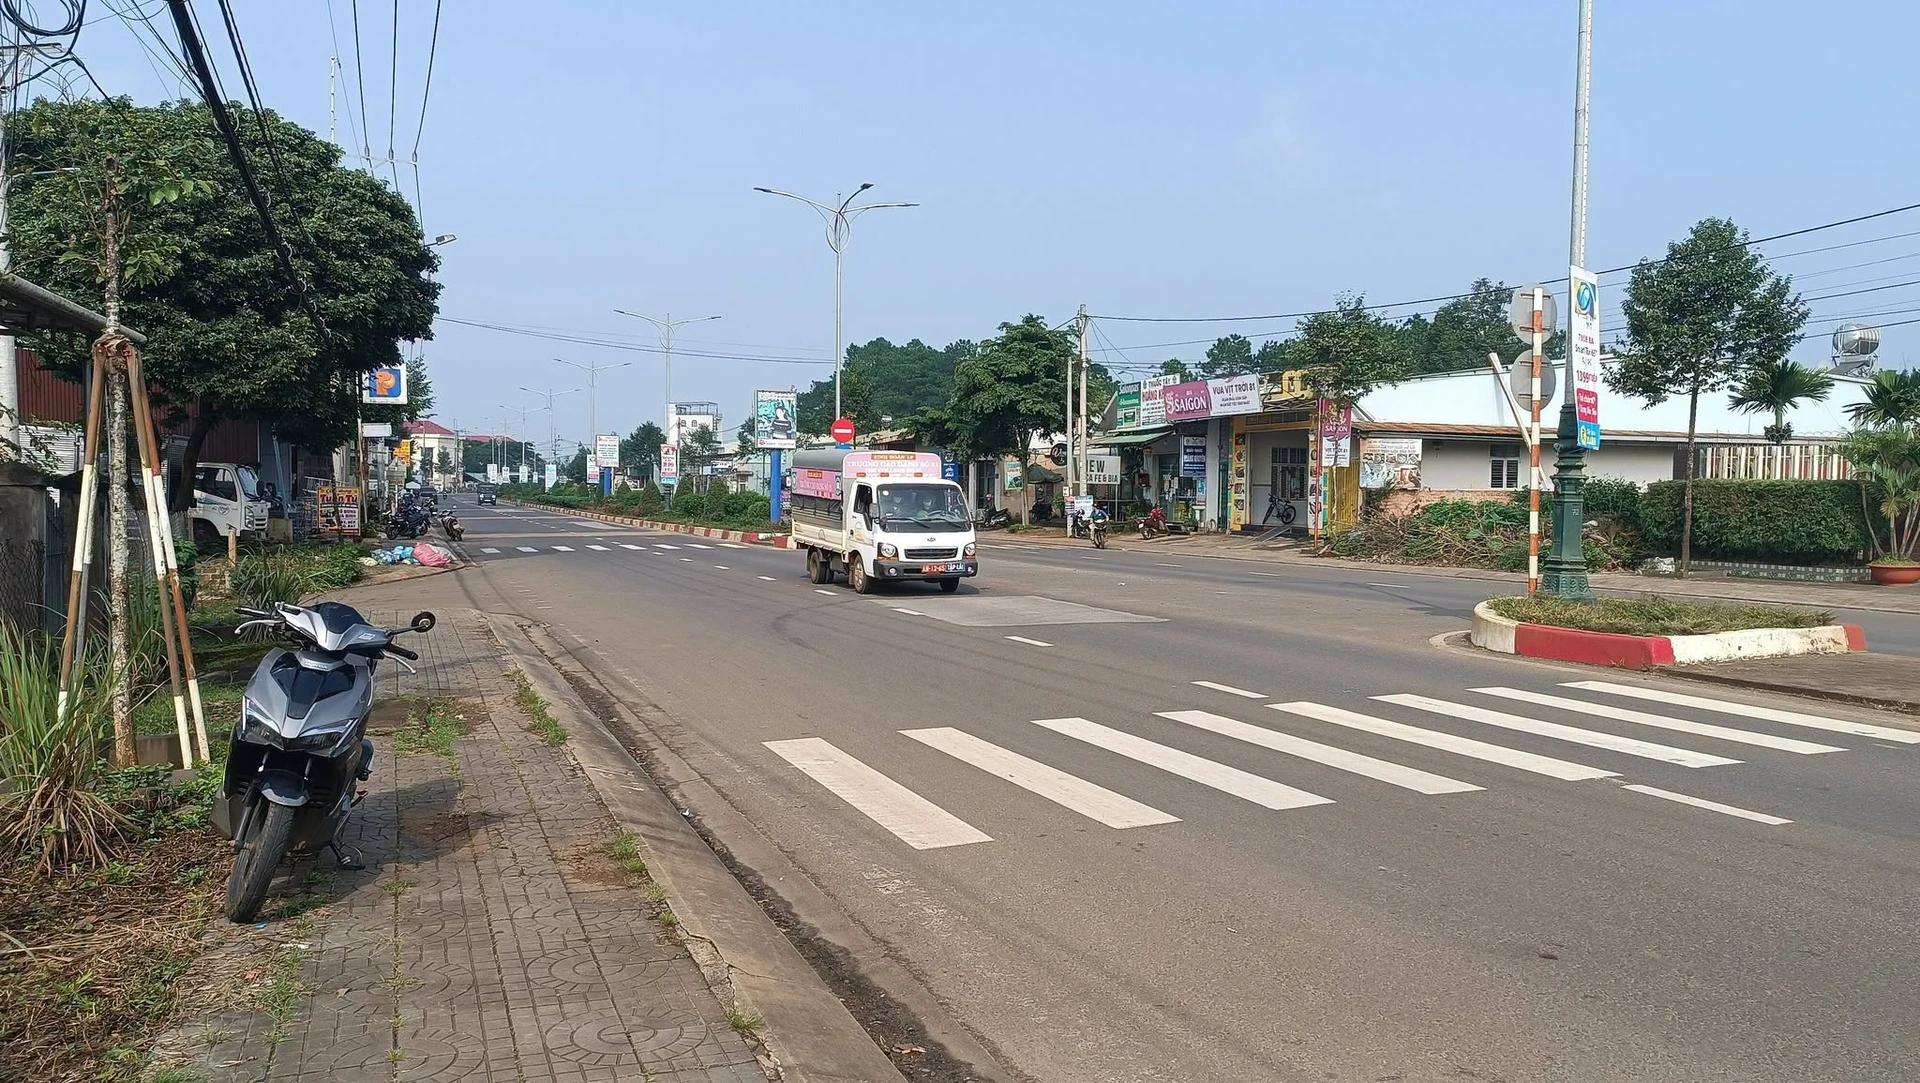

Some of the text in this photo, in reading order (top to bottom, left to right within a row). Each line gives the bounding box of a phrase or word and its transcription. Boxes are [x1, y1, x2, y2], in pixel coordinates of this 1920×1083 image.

[1212, 386, 1224, 395] VUA
[1225, 385, 1234, 396] VỊT
[1249, 382, 1256, 391] 81
[1174, 396, 1207, 412] SAIGON
[320, 494, 343, 502] Tun
